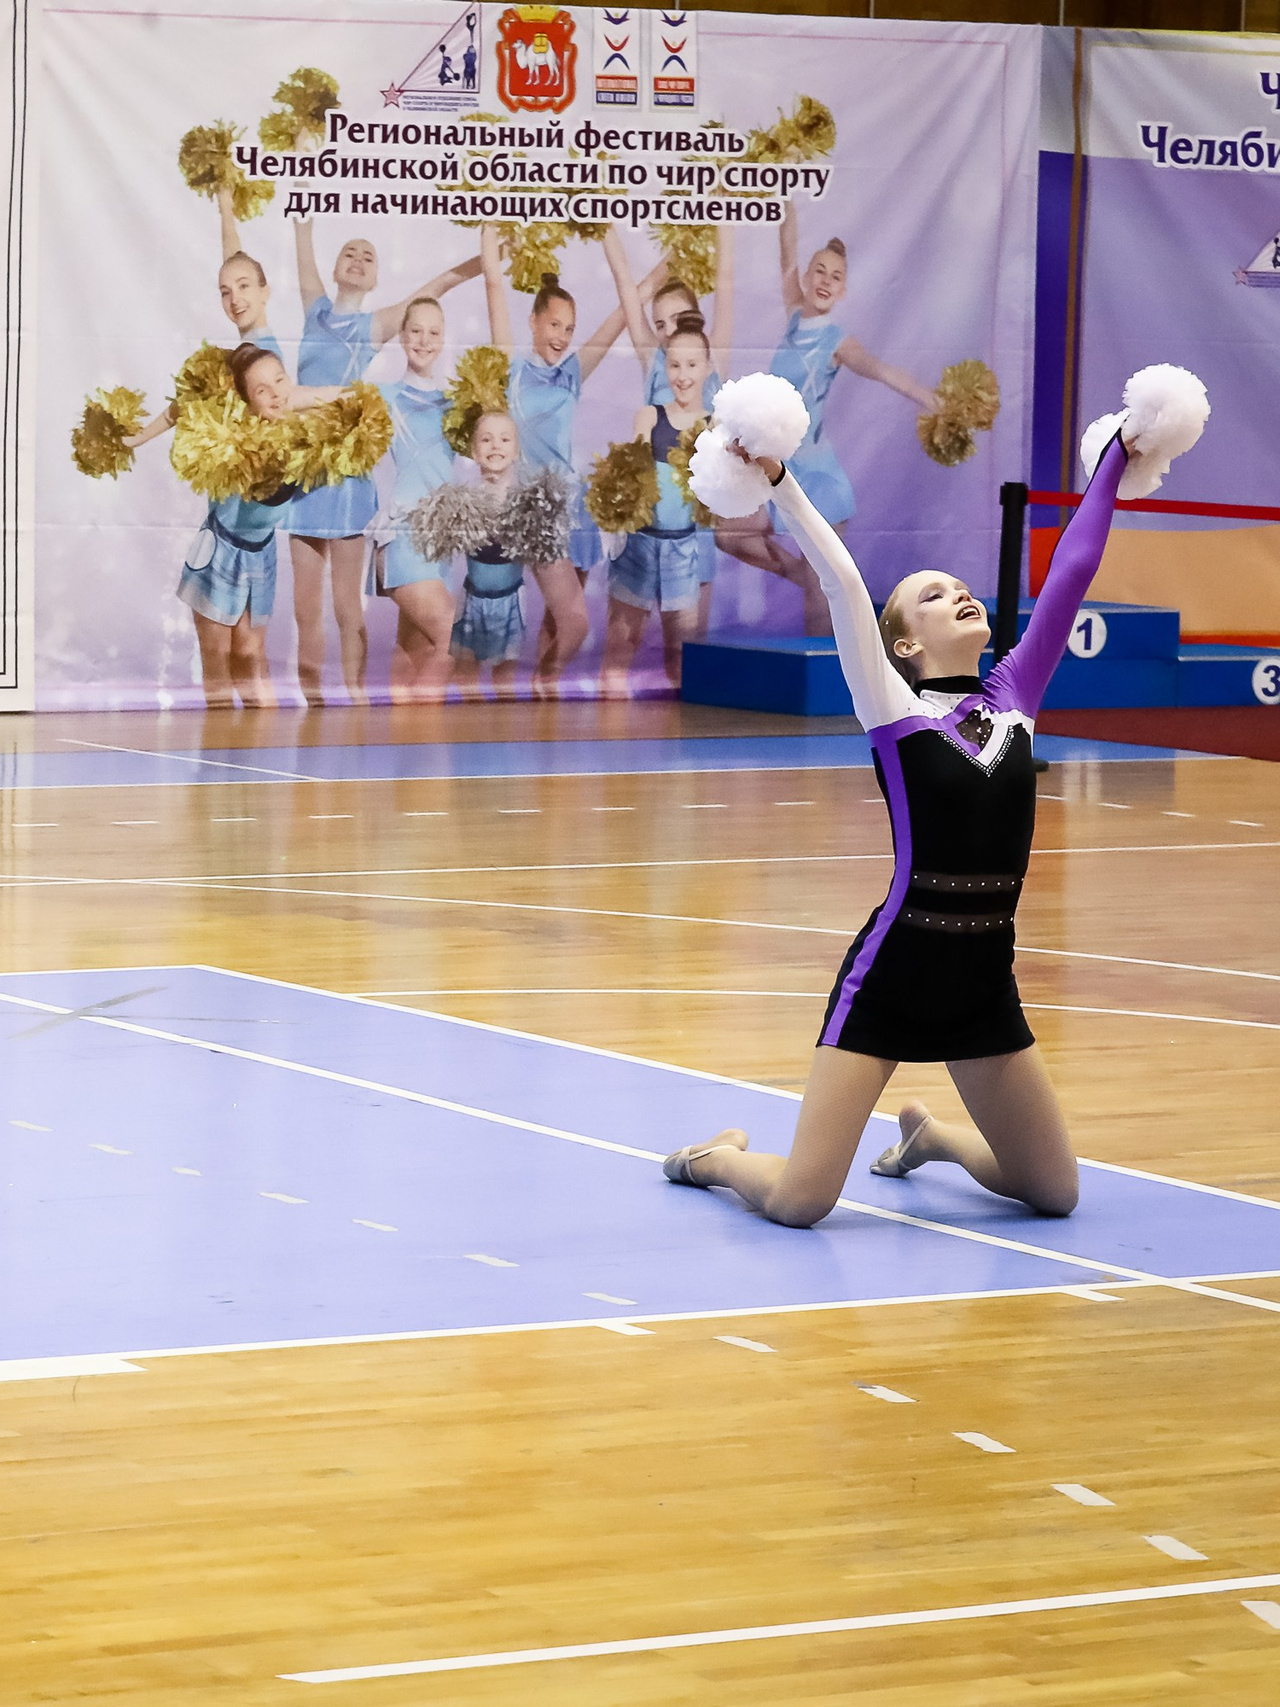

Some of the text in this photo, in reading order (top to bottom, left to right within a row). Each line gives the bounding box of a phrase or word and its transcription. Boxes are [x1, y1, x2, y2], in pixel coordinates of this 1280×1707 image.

[329, 113, 745, 157] Региональный фестиваль
[235, 146, 830, 197] Челябинской области по чир спорту
[284, 191, 782, 228] для начинающих спортсменов
[1076, 617, 1093, 651] 1
[1261, 664, 1280, 697] 3
